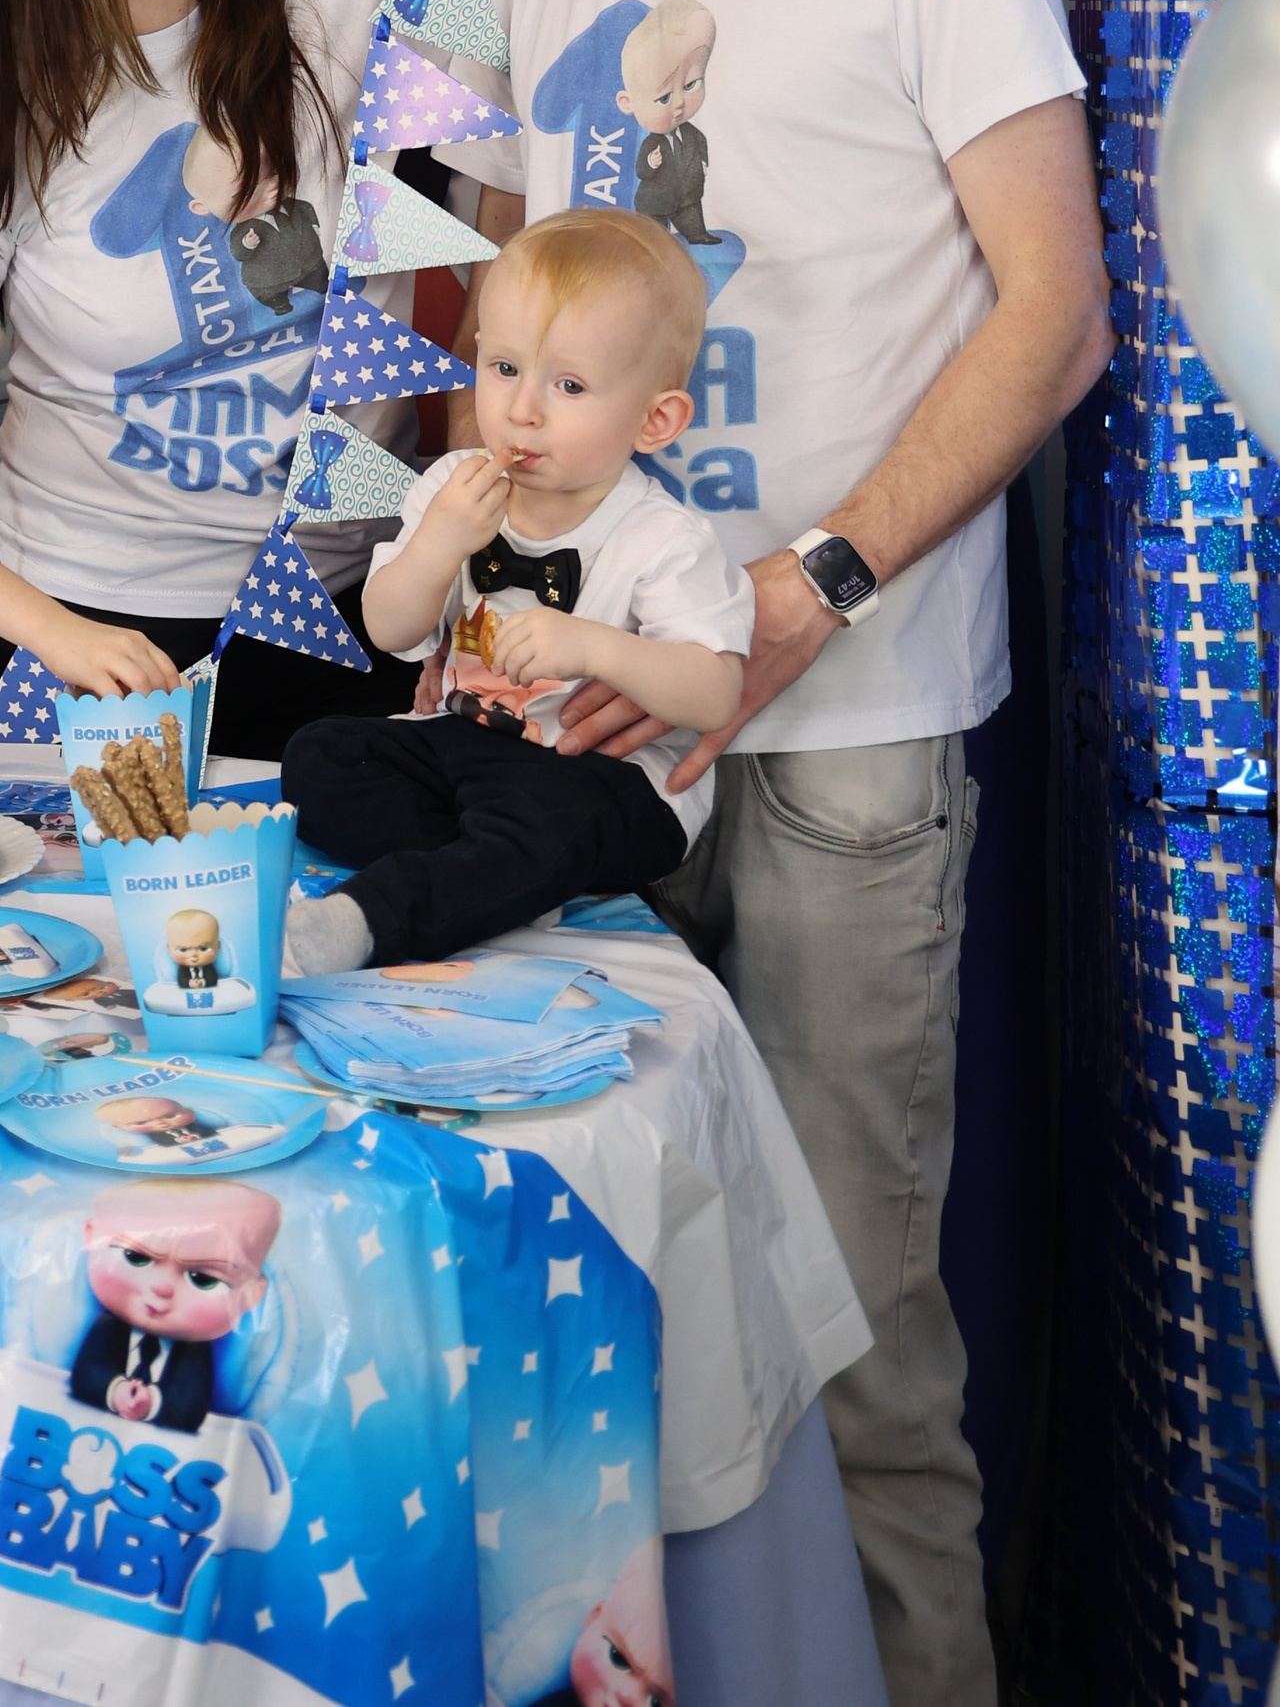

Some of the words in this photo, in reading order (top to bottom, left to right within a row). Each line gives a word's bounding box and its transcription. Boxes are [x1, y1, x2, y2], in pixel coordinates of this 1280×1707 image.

[177, 226, 237, 346] СТАЖ
[74, 727, 119, 741] BORN
[125, 724, 184, 741] LEAD
[125, 876, 178, 892] BORN
[185, 864, 252, 889] LEADER
[424, 987, 489, 1001] BORN
[18, 1092, 89, 1109] BORN
[93, 1056, 195, 1097] LEADER
[1, 1406, 228, 1534] BOSS
